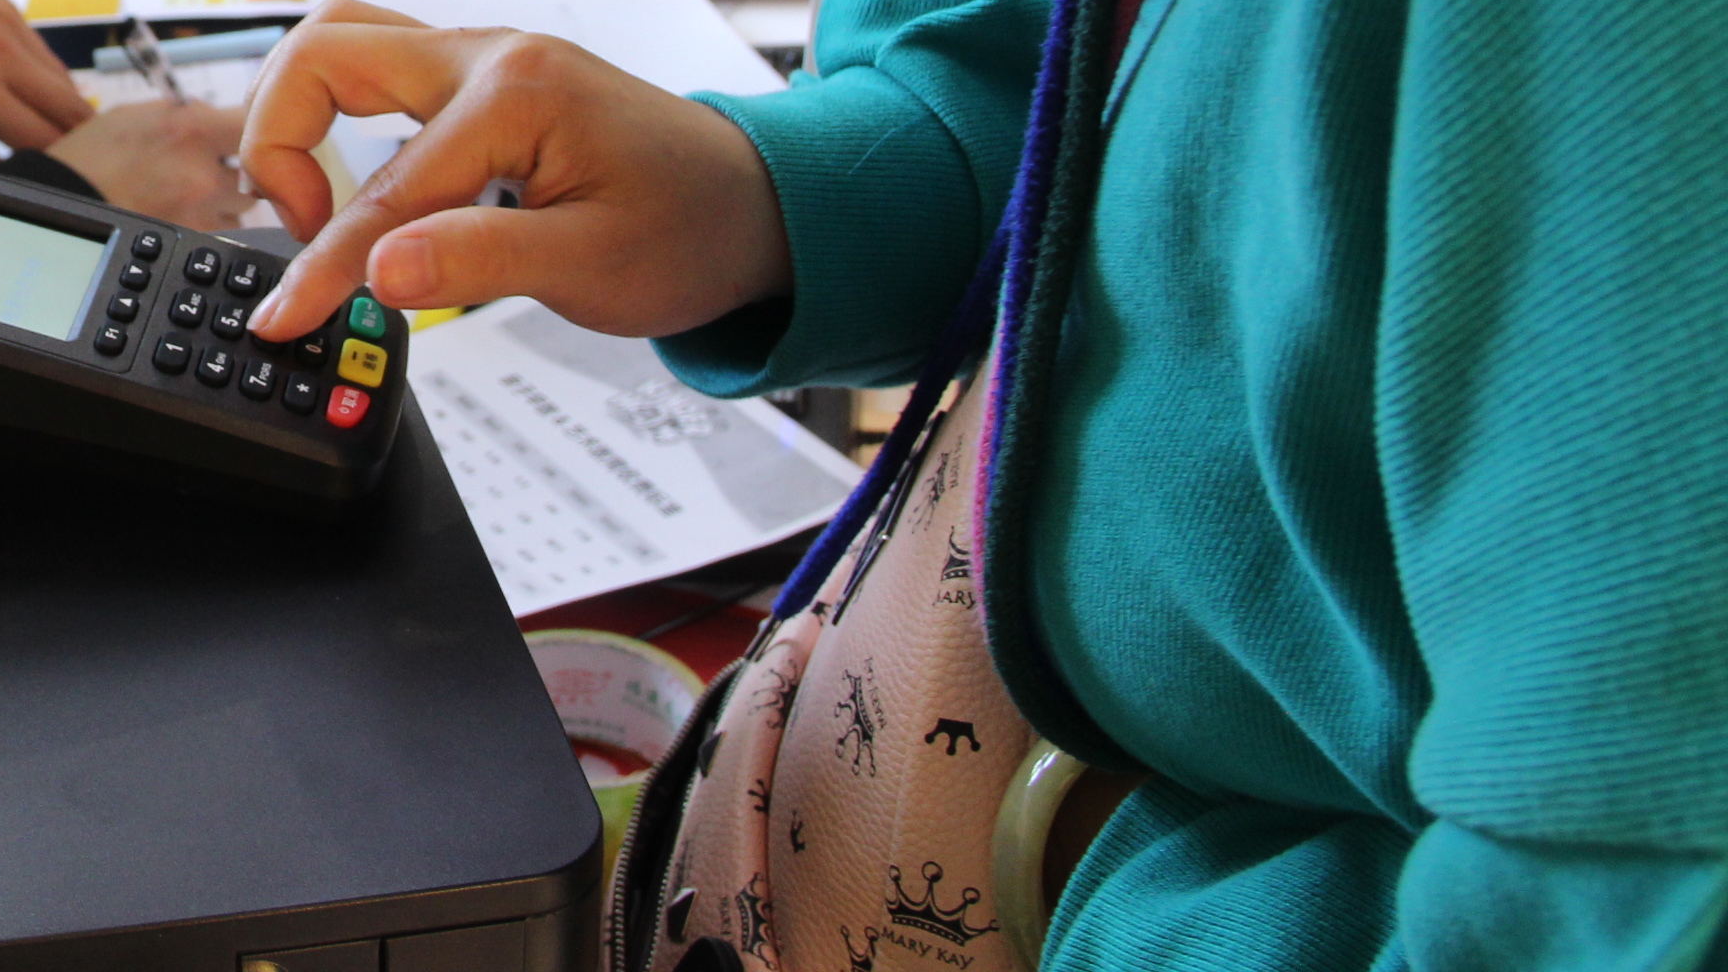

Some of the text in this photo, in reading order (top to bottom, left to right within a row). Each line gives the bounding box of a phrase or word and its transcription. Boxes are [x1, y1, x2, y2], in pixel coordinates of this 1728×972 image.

[142, 235, 157, 247] F2
[194, 262, 212, 273] 3
[234, 275, 253, 286] 6
[179, 303, 198, 316] 2
[220, 316, 239, 328] 5
[104, 327, 120, 340] F1
[165, 342, 185, 352] 1
[305, 343, 322, 354] 0
[206, 362, 225, 374] 4
[249, 374, 268, 387] 7
[880, 925, 975, 970] MARY KAY
